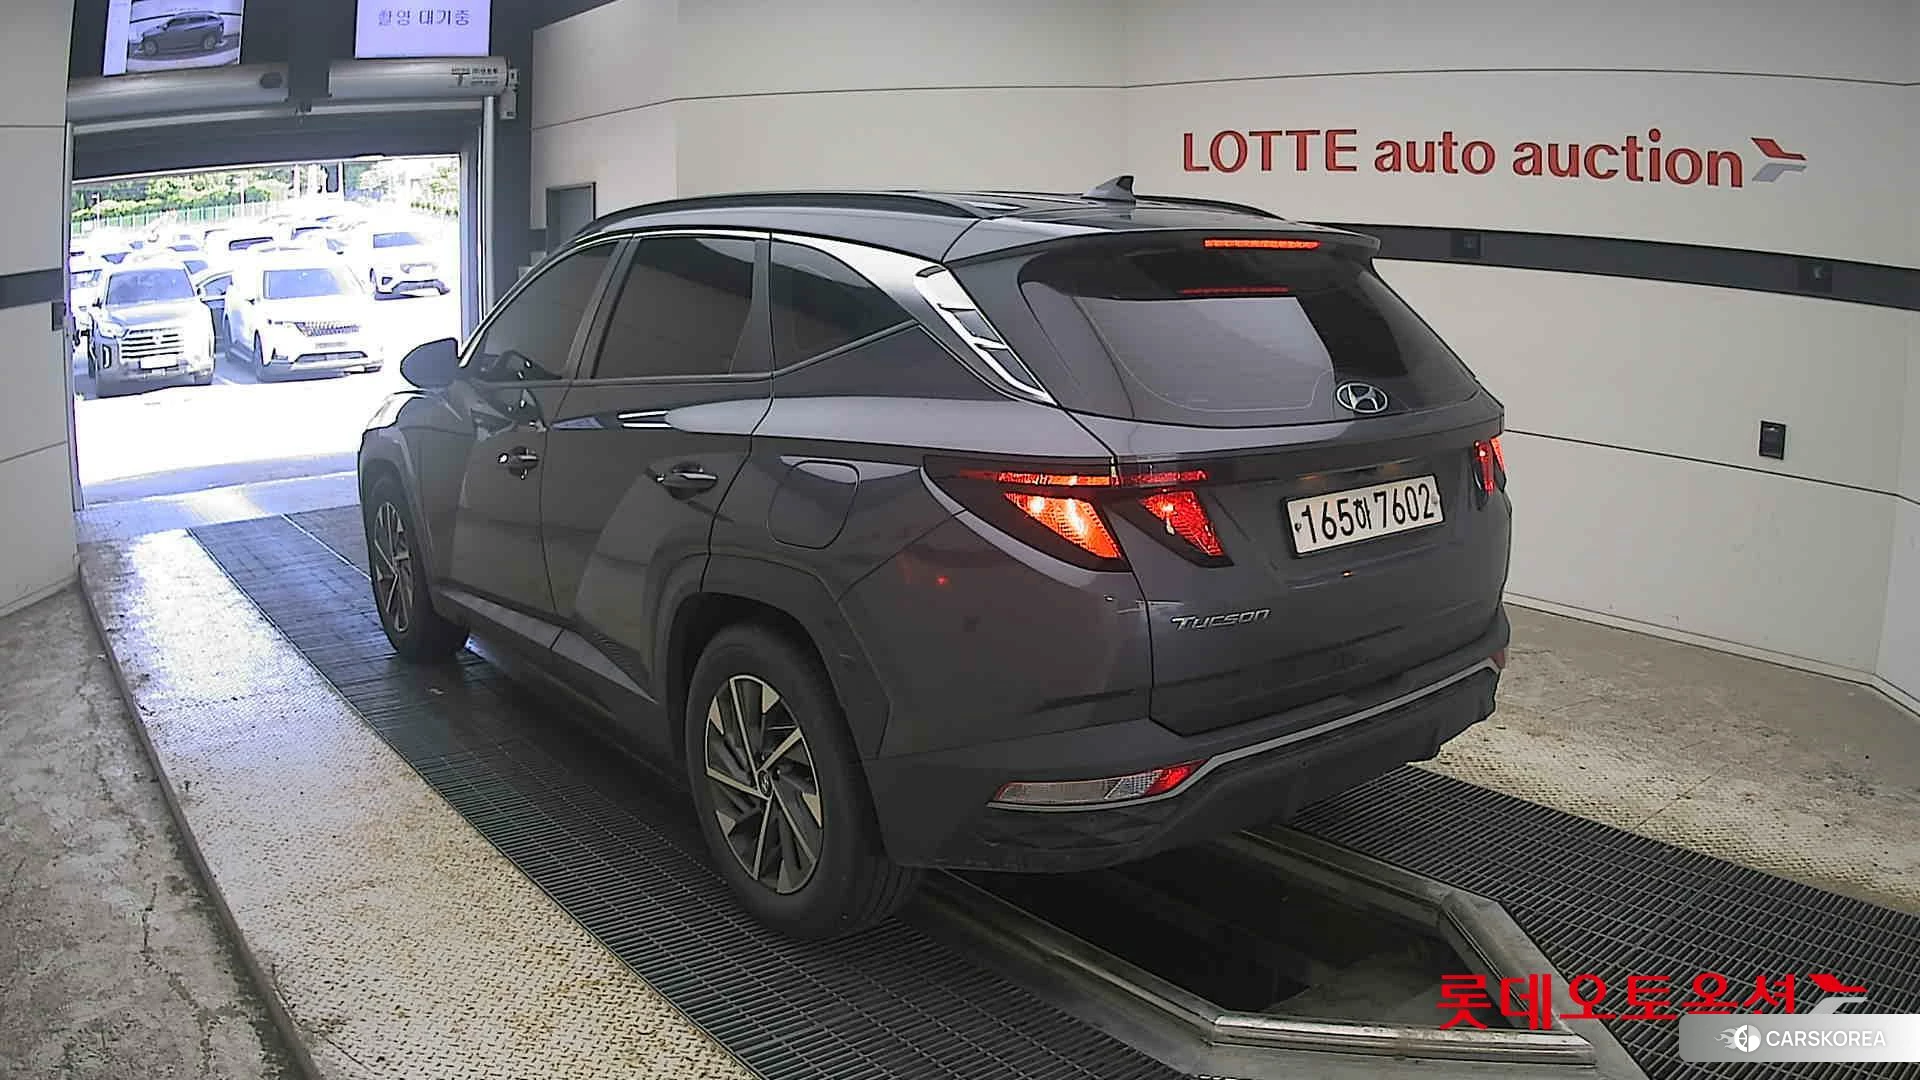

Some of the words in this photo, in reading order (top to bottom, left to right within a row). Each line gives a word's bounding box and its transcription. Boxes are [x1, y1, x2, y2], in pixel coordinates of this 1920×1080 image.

[419, 9, 470, 26] 대기중
[1183, 129, 1358, 173] LOTTE
[1374, 132, 1497, 174] auto
[1512, 129, 1744, 188] auction
[1172, 608, 1271, 632] Tucson
